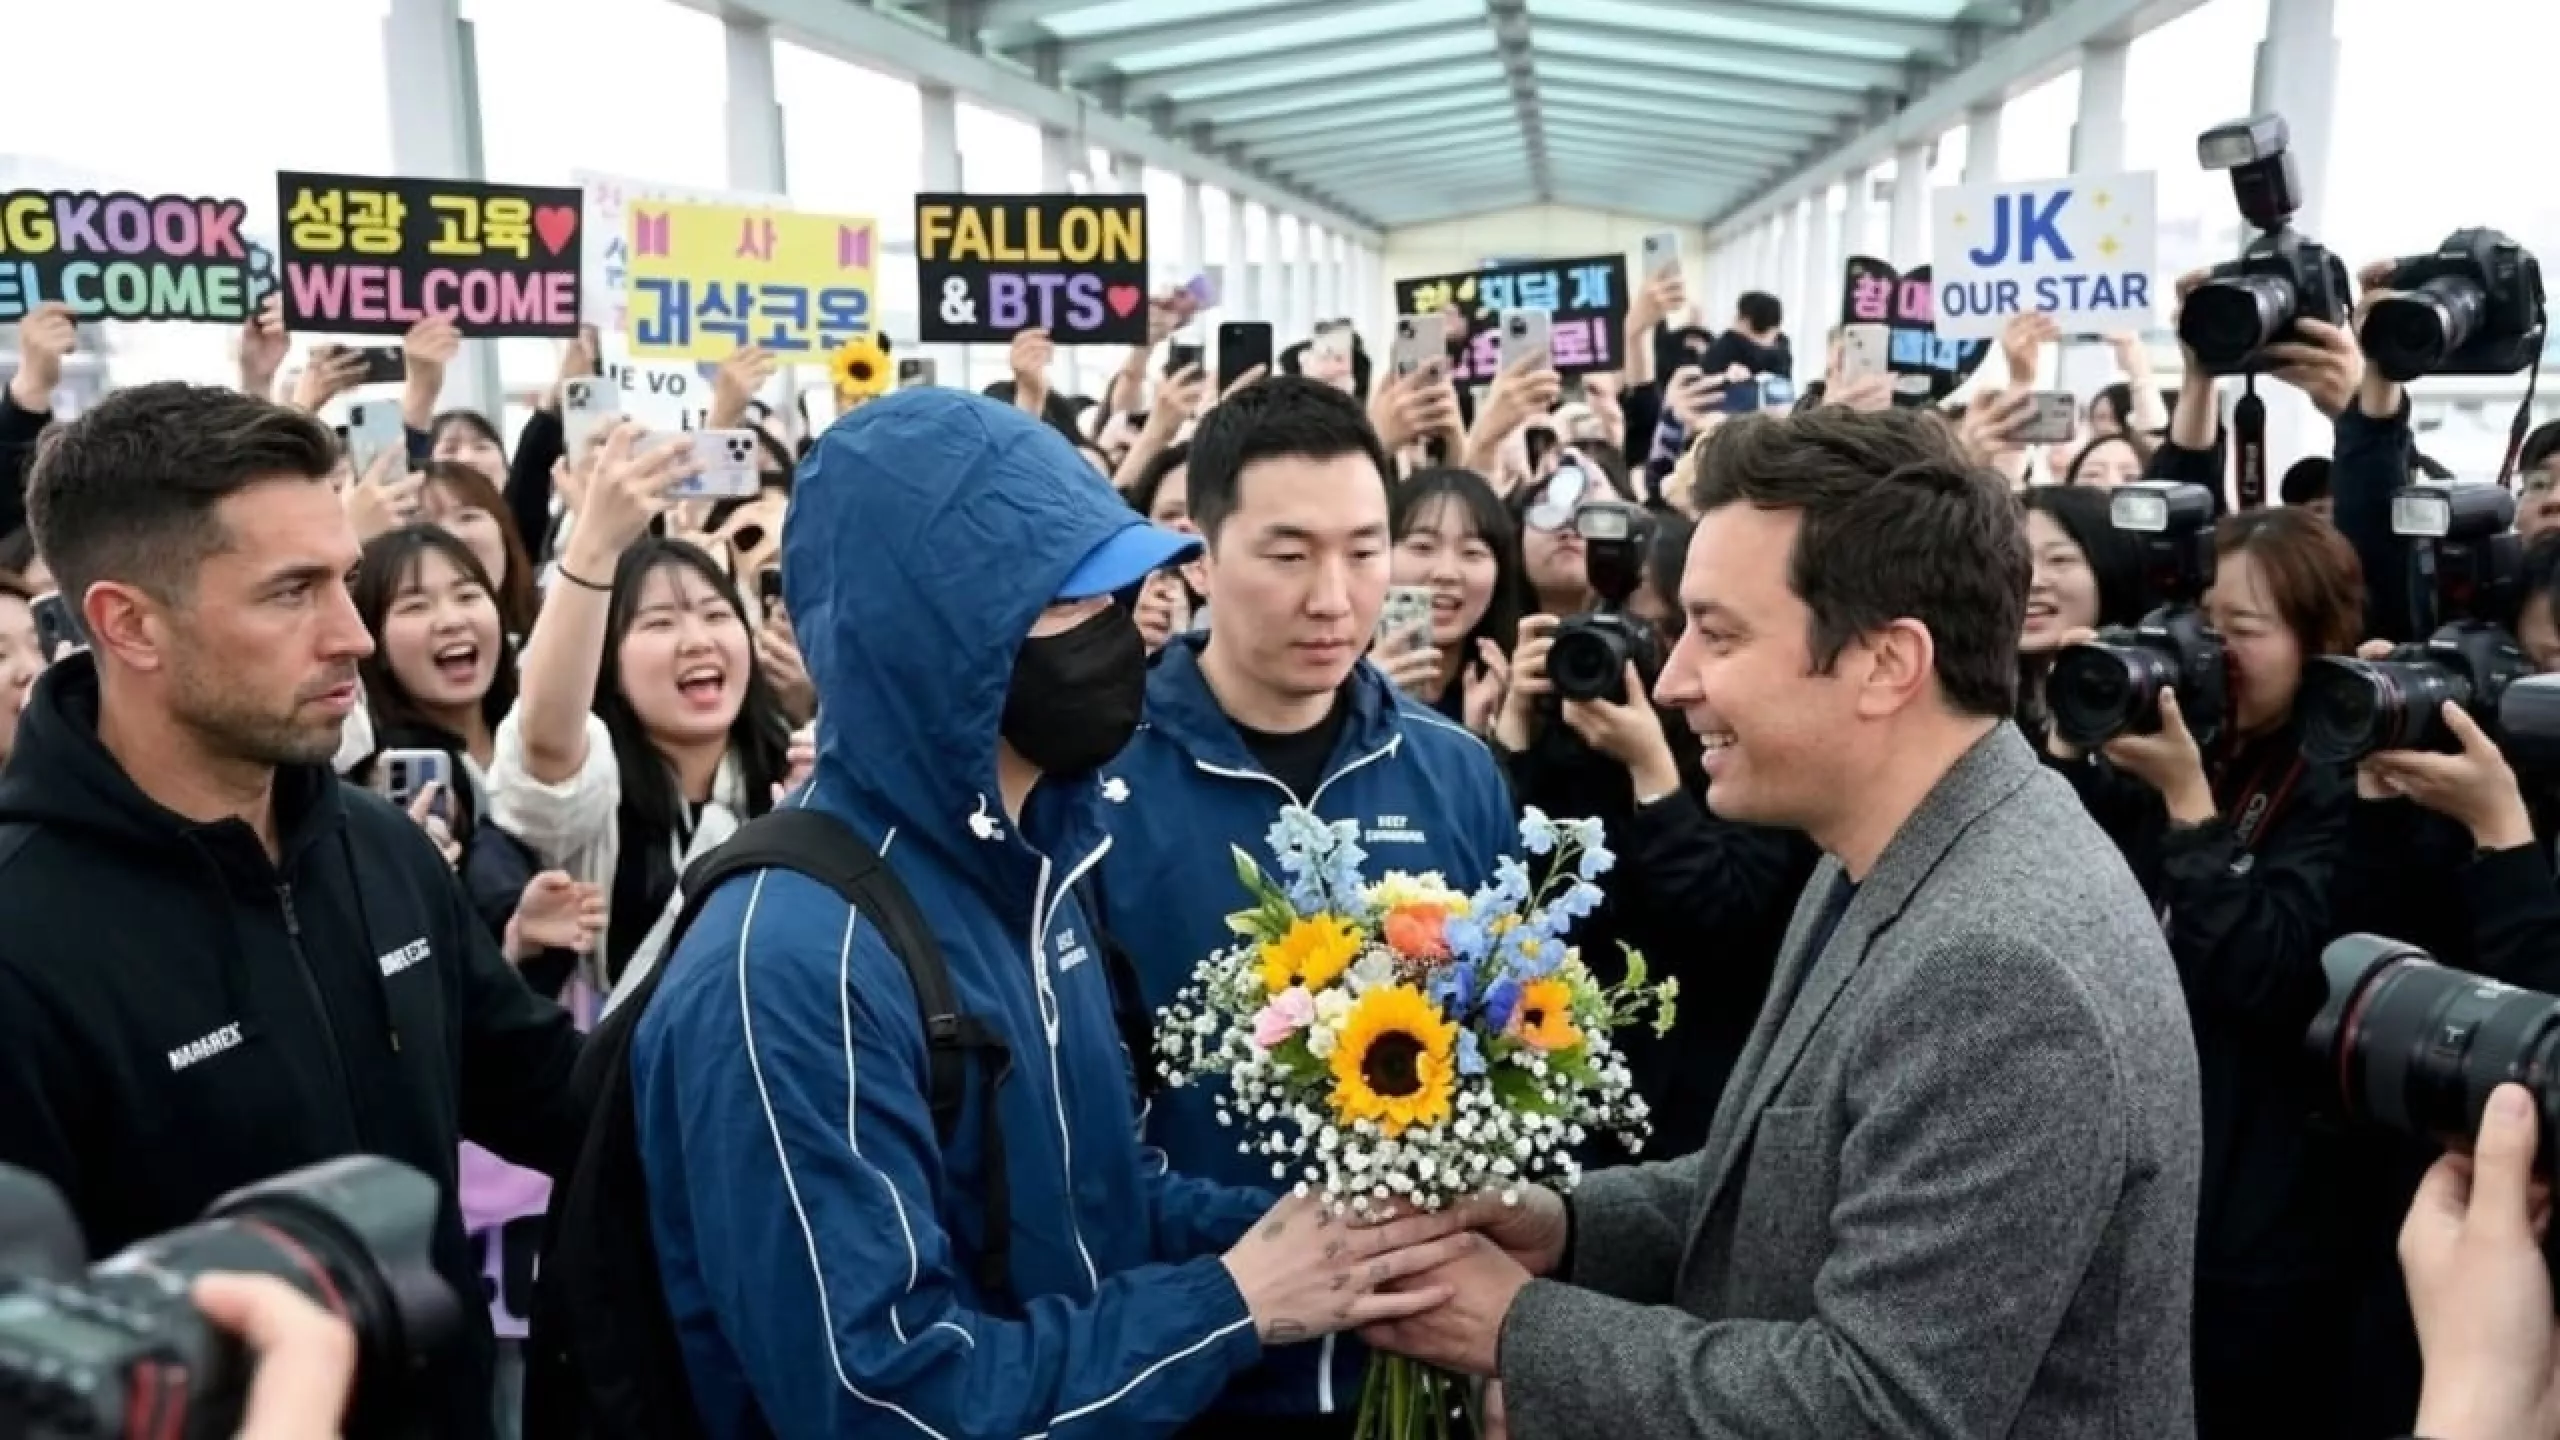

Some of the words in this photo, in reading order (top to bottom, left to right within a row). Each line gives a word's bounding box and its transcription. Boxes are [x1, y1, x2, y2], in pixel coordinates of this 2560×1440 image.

[0, 196, 247, 258] GKOOK
[288, 187, 407, 253] 성광
[919, 206, 1143, 263] FALLON
[1968, 189, 2076, 267] JK
[287, 262, 577, 325] WELCOME
[940, 275, 978, 325] &
[988, 272, 1105, 331] BTS
[1942, 278, 2020, 317] OUR
[2034, 272, 2150, 313] STAR
